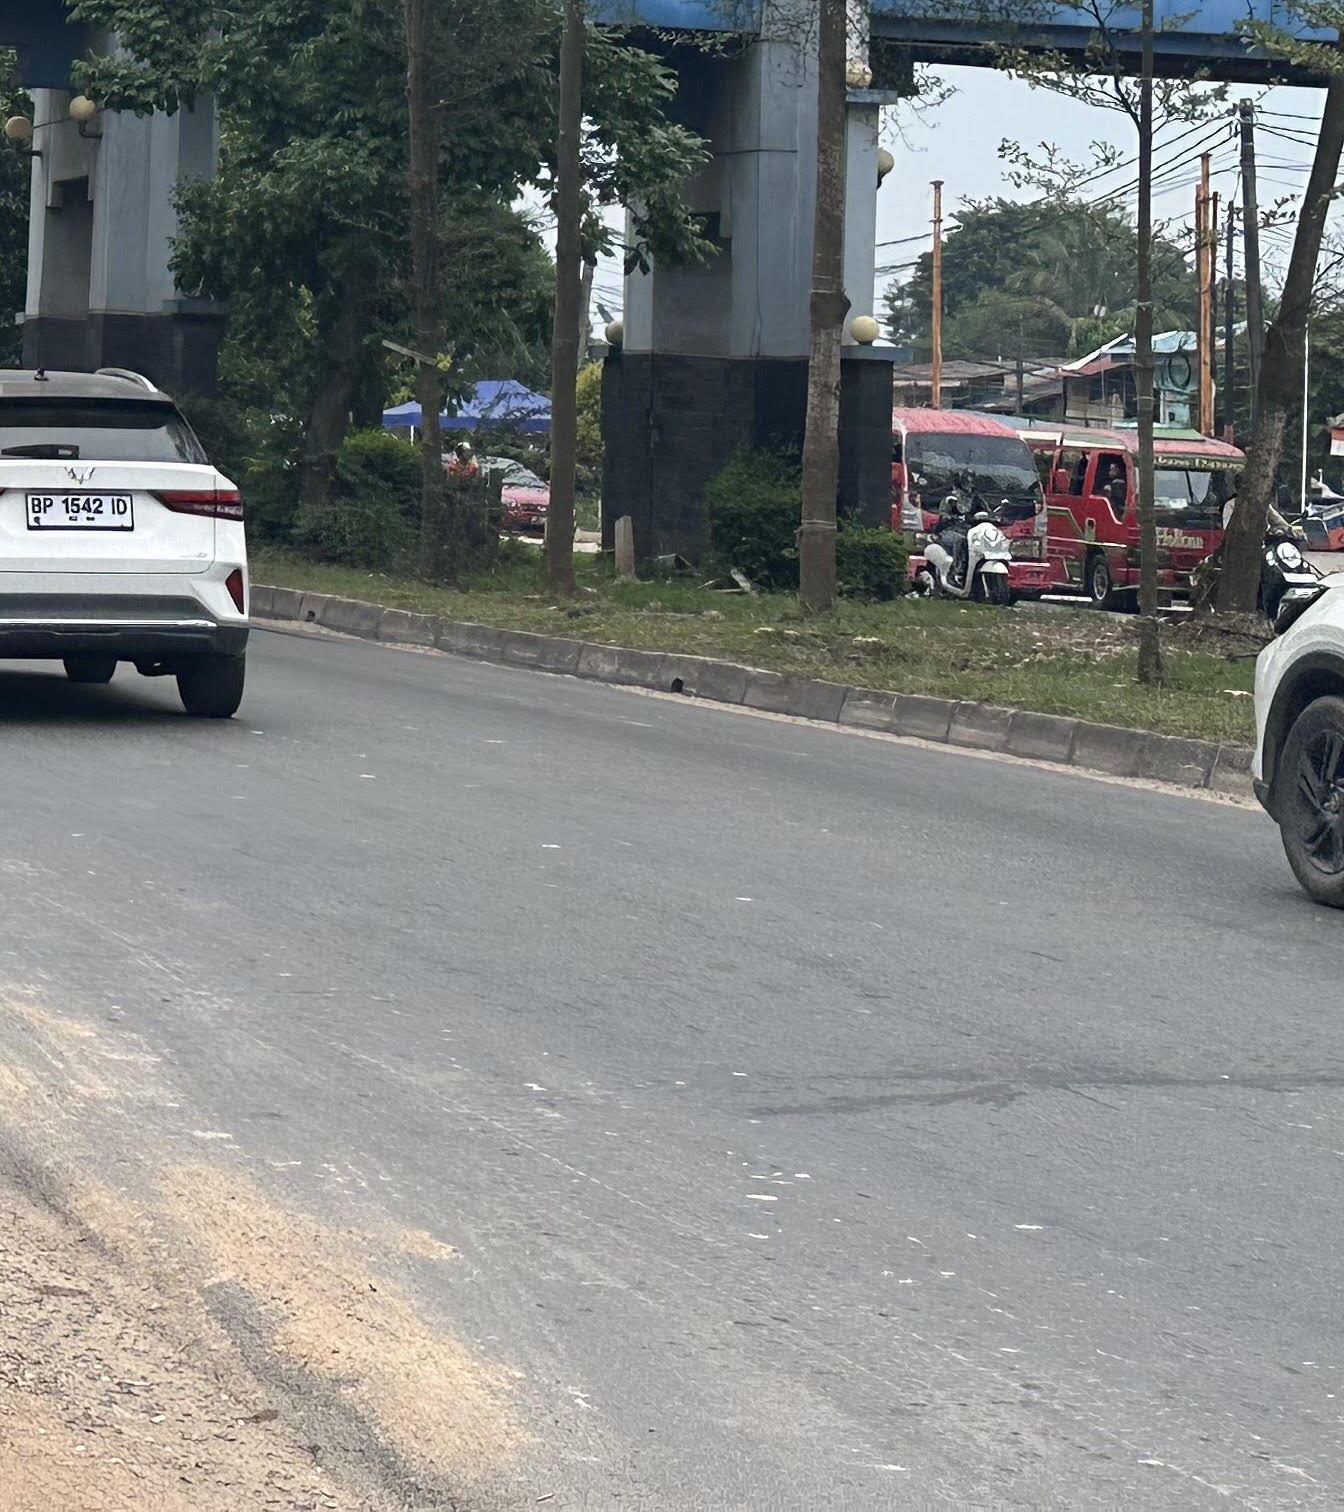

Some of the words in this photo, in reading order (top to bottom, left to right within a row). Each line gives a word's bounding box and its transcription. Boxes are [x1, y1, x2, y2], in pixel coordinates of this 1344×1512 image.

[31, 497, 54, 514] BP
[62, 497, 103, 514] 1542
[111, 498, 127, 515] ID
